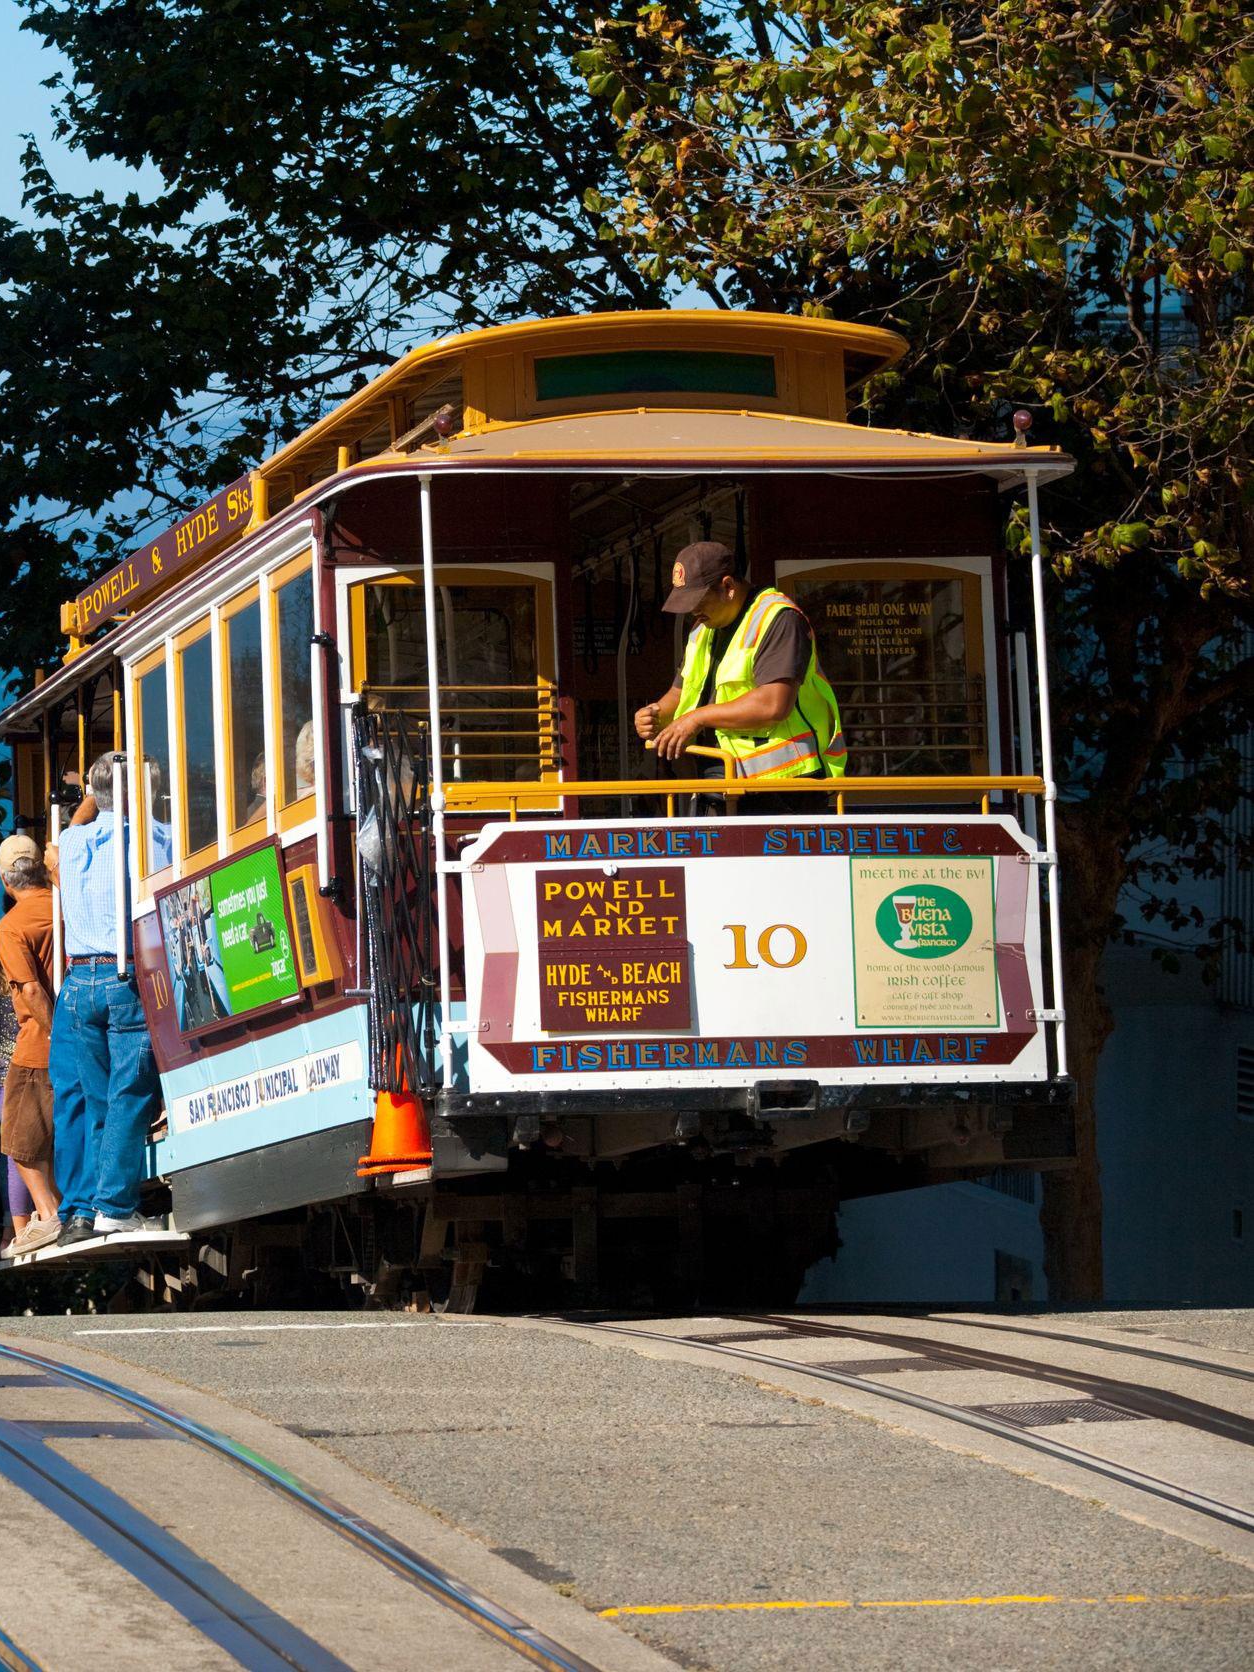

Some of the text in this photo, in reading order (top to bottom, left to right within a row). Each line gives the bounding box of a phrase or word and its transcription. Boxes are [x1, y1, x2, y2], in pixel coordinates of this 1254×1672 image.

[82, 487, 254, 624] POWELL & HYDE Sts.
[826, 601, 933, 617] FARE $6.00 ONE WAY
[859, 618, 900, 626] HOLD ON
[837, 627, 923, 637] KEEP YELLOW FLOOR
[852, 637, 909, 646] AREA CLEAR
[847, 646, 917, 656] NO TRANSFERS
[545, 830, 719, 859] MARKET
[763, 826, 926, 854] STREET
[859, 867, 895, 879] meet
[898, 868, 919, 879] me
[940, 867, 963, 879] the
[217, 876, 268, 919] sometimes you just
[544, 879, 676, 901] POWELL
[580, 901, 645, 917] AND
[917, 896, 936, 907] the
[221, 921, 236, 949] need
[543, 916, 679, 938] MARKET
[722, 924, 807, 969] 10
[546, 962, 682, 986] HYDE AND BEACH
[866, 963, 890, 972] home
[894, 963, 904, 973] of
[906, 962, 922, 972] the
[150, 970, 169, 1010] 10
[558, 990, 670, 1007] FISHERMANS
[940, 991, 964, 1002] shop
[585, 1007, 643, 1022] WHARF
[532, 1036, 988, 1071] FISHERMANS WHARF
[189, 1094, 206, 1124] SAN
[304, 1053, 341, 1088] AILWAY
